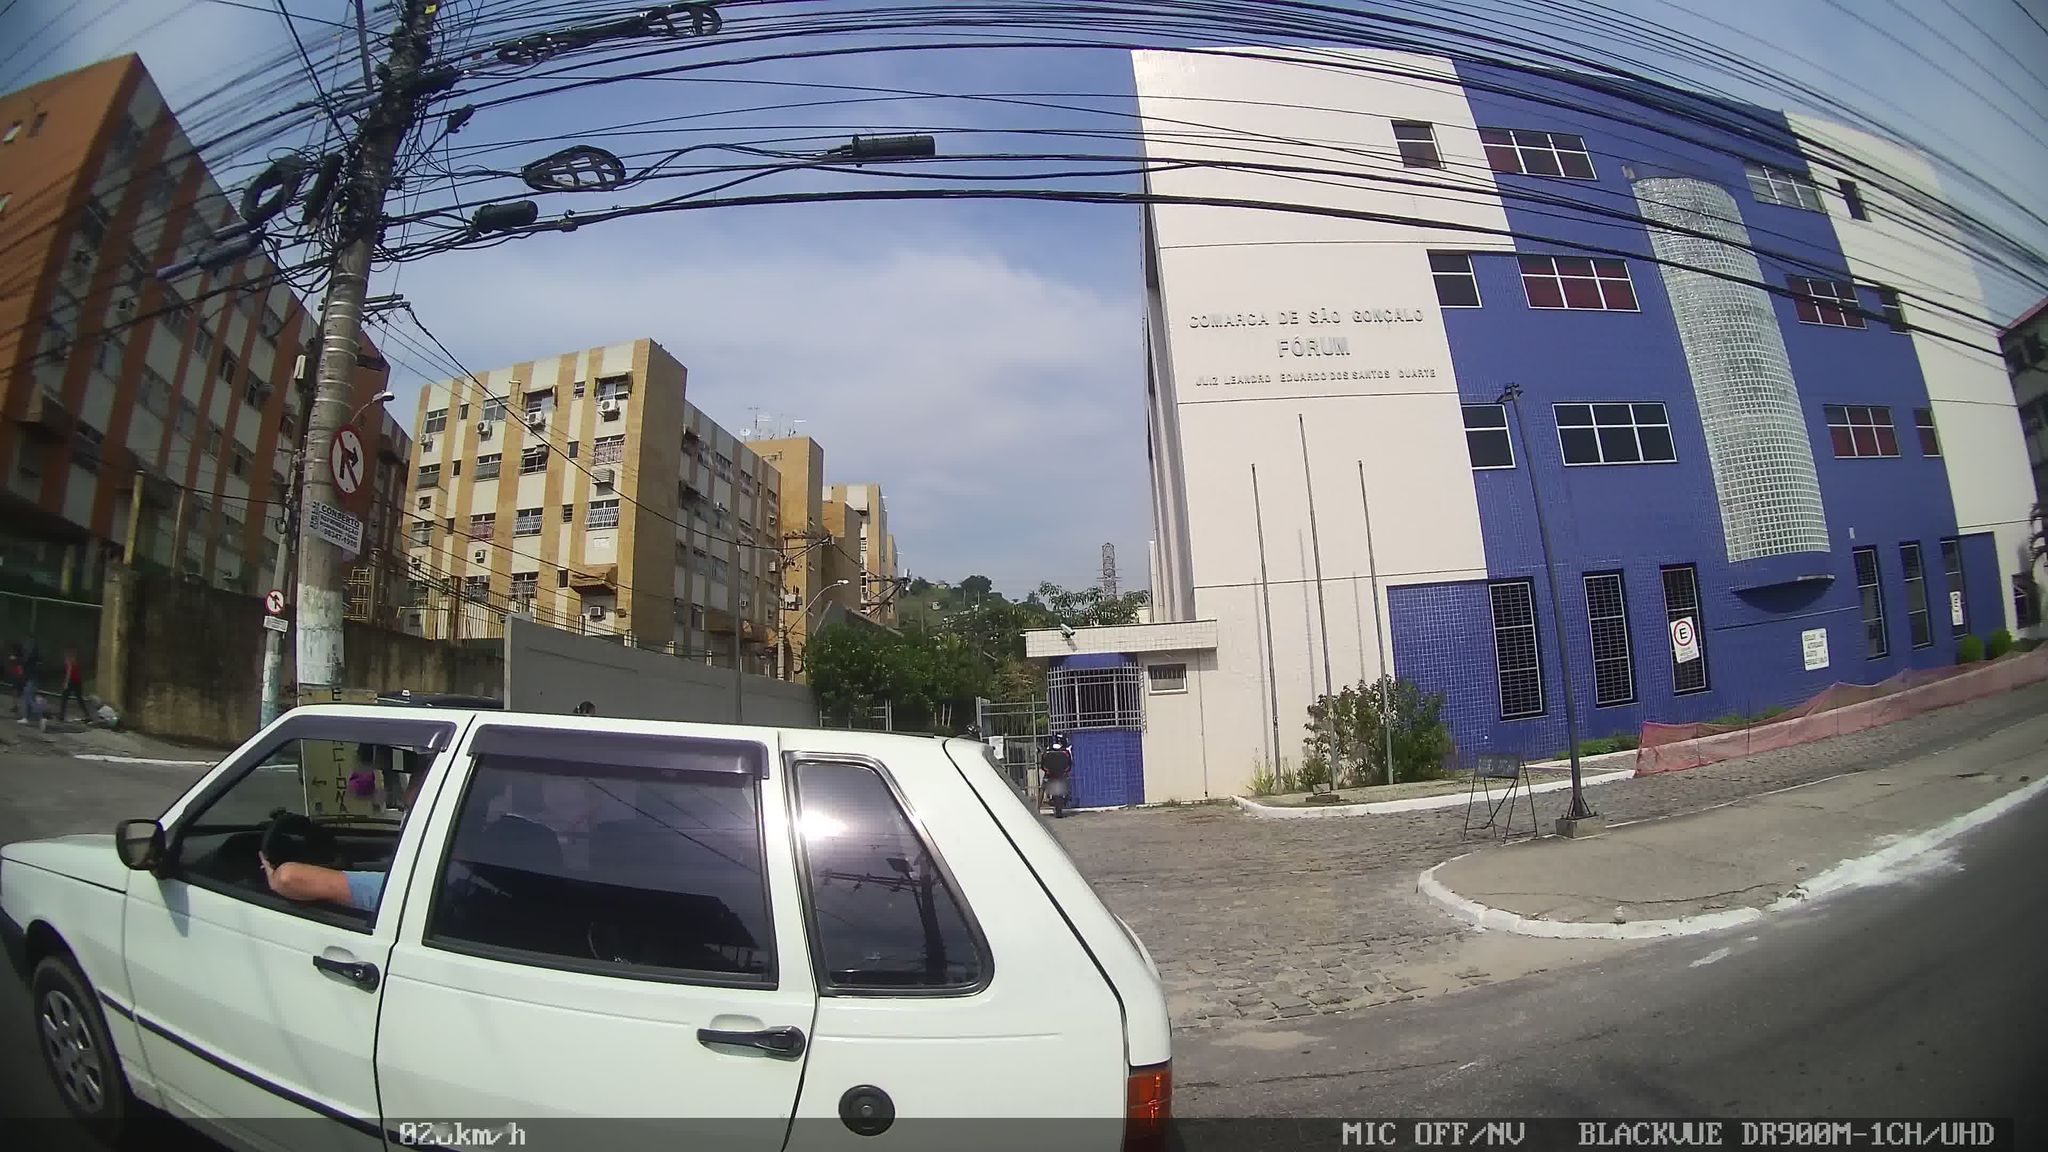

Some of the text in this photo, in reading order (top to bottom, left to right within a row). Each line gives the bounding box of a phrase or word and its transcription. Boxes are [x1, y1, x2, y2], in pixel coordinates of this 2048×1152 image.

[1189, 307, 1424, 328] COMARCA DE SÃO GONÇALO
[1278, 336, 1350, 357] FÓRUM
[1224, 374, 1271, 385] LEANDRO
[1280, 371, 1327, 383] EDUARDO
[1330, 370, 1349, 381] DOS
[1352, 369, 1391, 380] SANTOS
[1399, 368, 1437, 379] DUARTE
[1679, 627, 1688, 640] E
